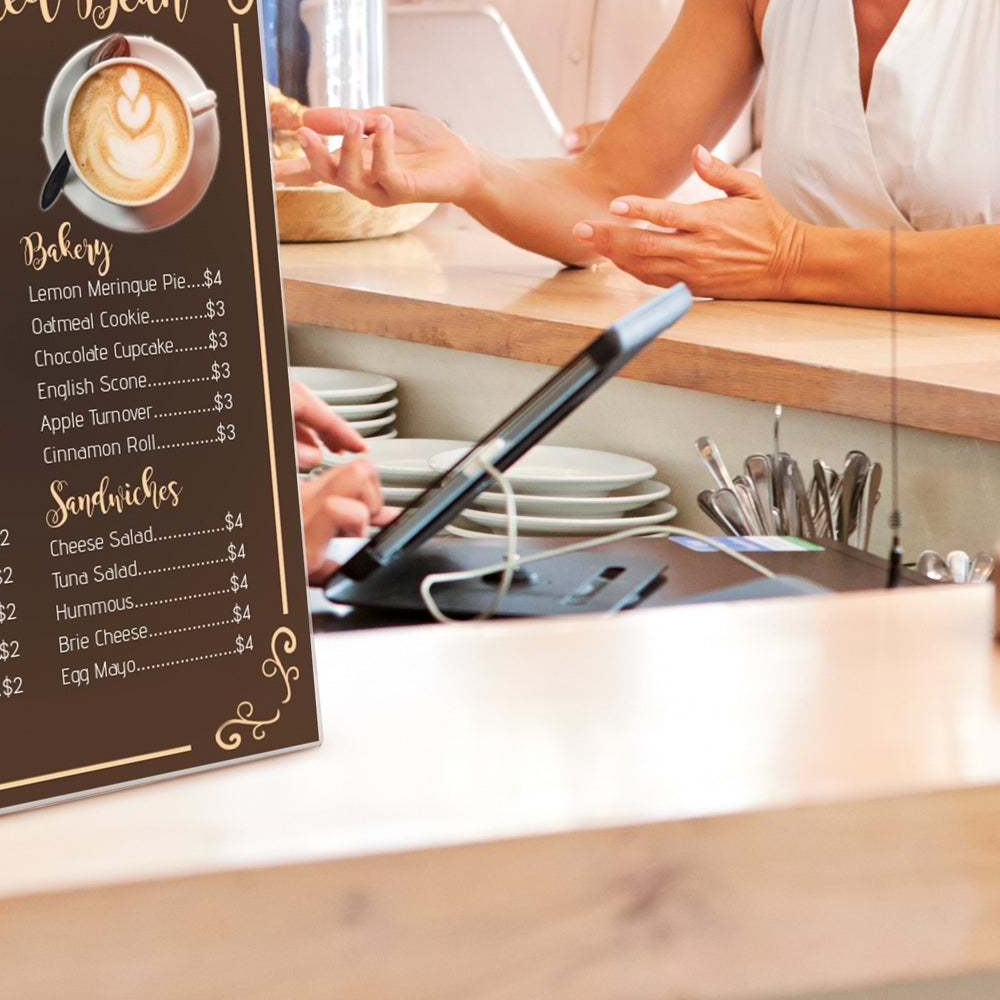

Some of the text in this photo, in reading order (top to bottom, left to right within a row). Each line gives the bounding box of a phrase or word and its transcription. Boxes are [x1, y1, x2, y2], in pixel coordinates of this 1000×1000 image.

[20, 221, 113, 277] Bakery
[28, 285, 82, 303] Lemon
[163, 272, 186, 290] Pie
[203, 267, 223, 289] $4
[31, 299, 226, 335] Oatmeal Cookie $3
[34, 330, 228, 367] Chocolate Cupcake $3
[37, 361, 231, 401] English Scone $3
[40, 392, 233, 434] Apple Turnover $3
[43, 423, 236, 464] Cinnamon Roll $3
[45, 465, 183, 529] Sandwiches
[50, 511, 244, 557] Cheese Salad $4
[51, 542, 246, 589] Tuna Salad $4
[55, 572, 249, 621] Hummous $4
[58, 603, 251, 653] Brie Cheese $4
[0, 639, 20, 662] $2
[61, 634, 254, 688] Egg Mayo $4
[2, 675, 24, 698] $2
